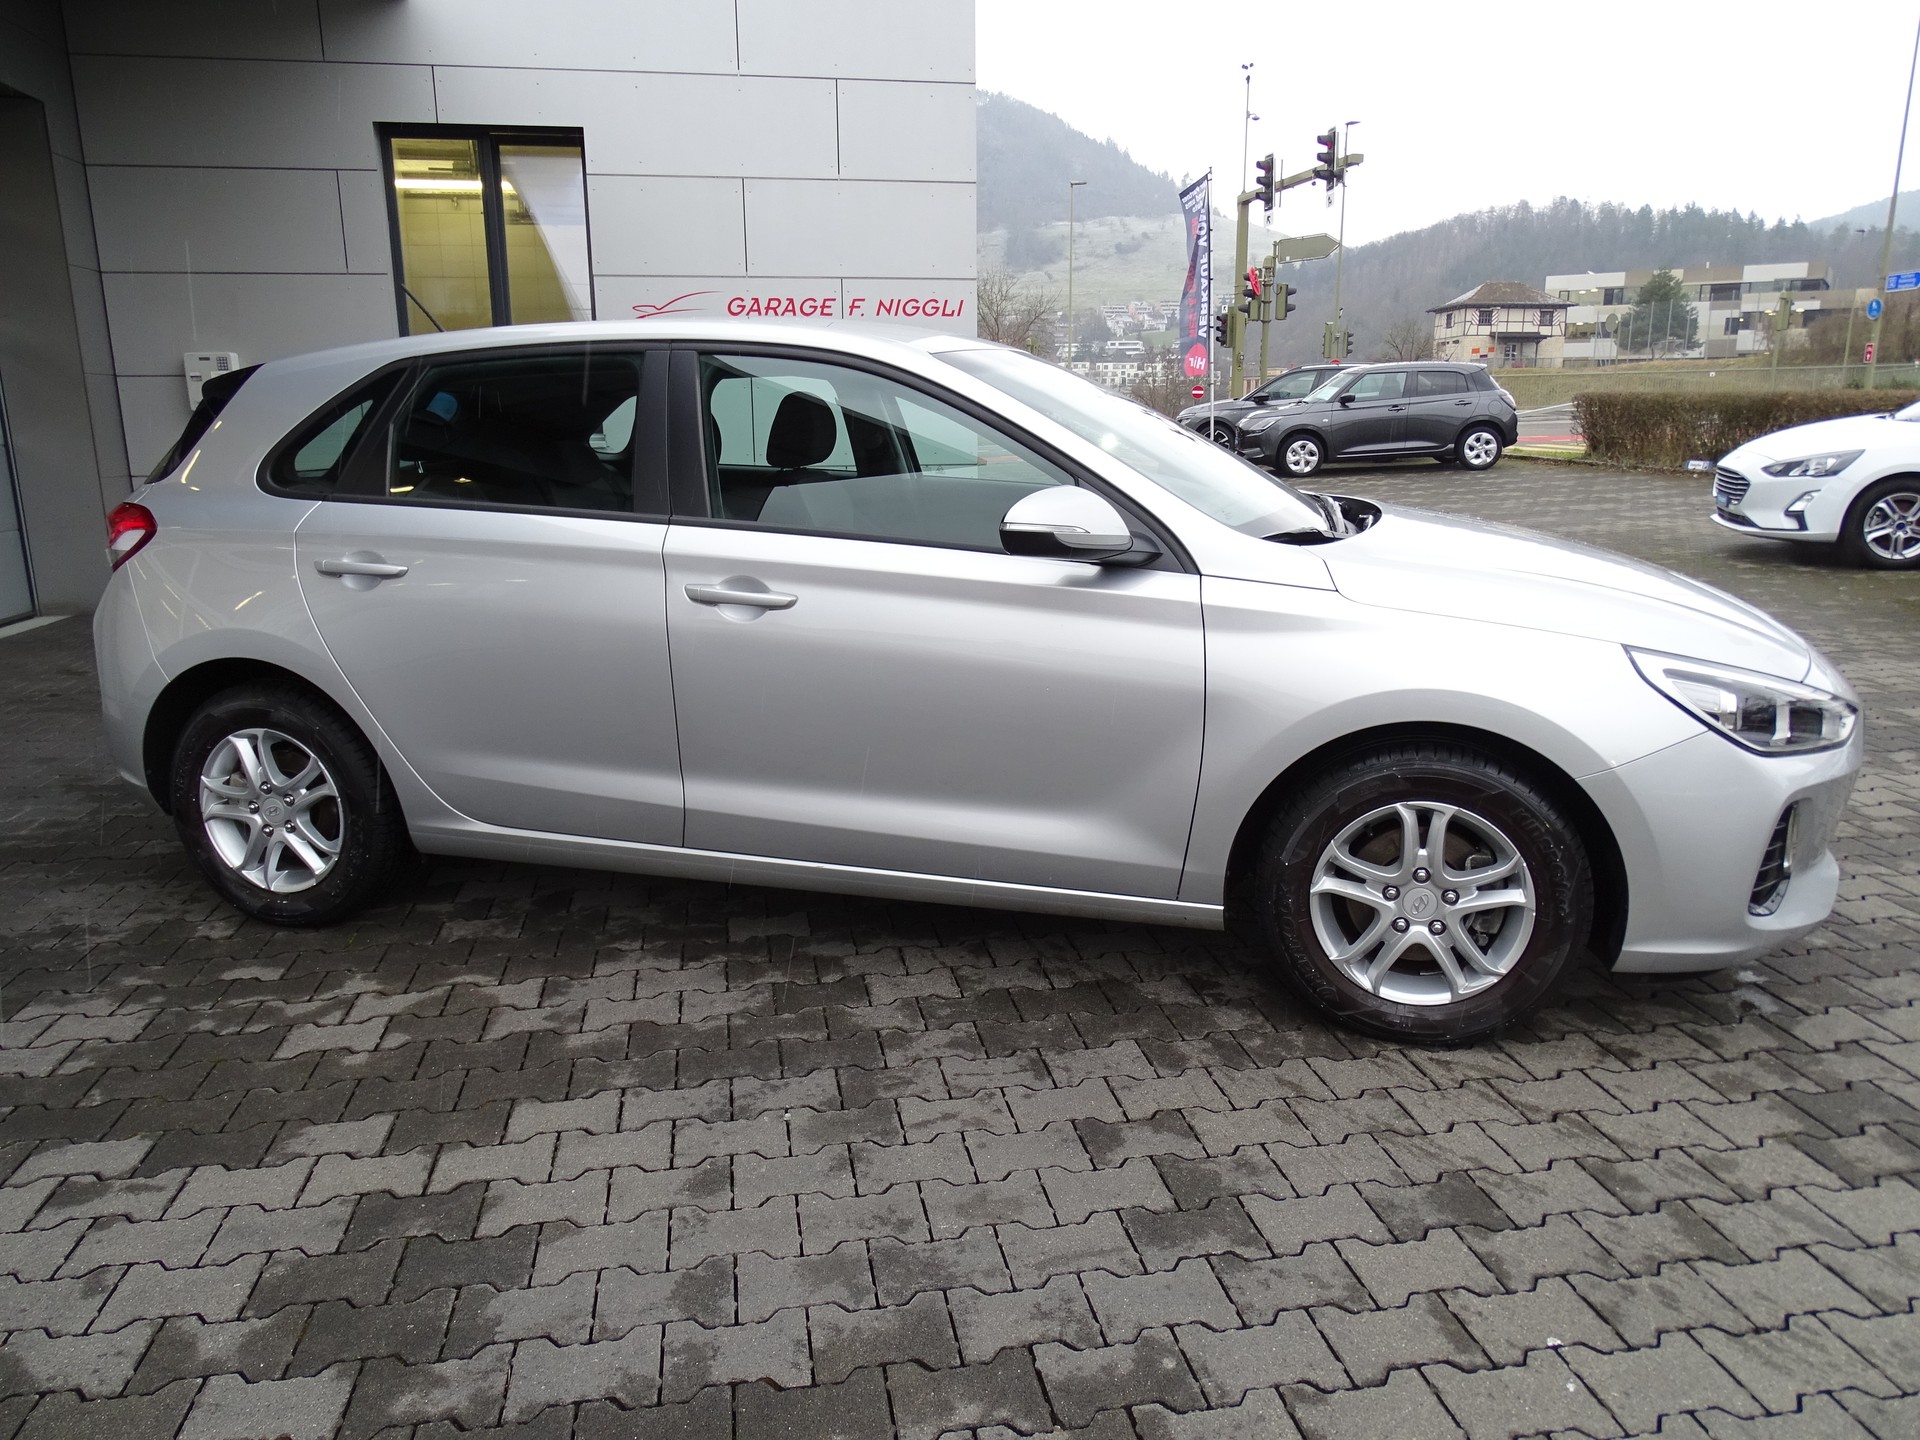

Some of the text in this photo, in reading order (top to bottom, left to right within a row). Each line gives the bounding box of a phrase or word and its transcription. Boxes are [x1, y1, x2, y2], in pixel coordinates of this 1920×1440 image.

[727, 297, 964, 317] GARAGE F. NIGGLI
